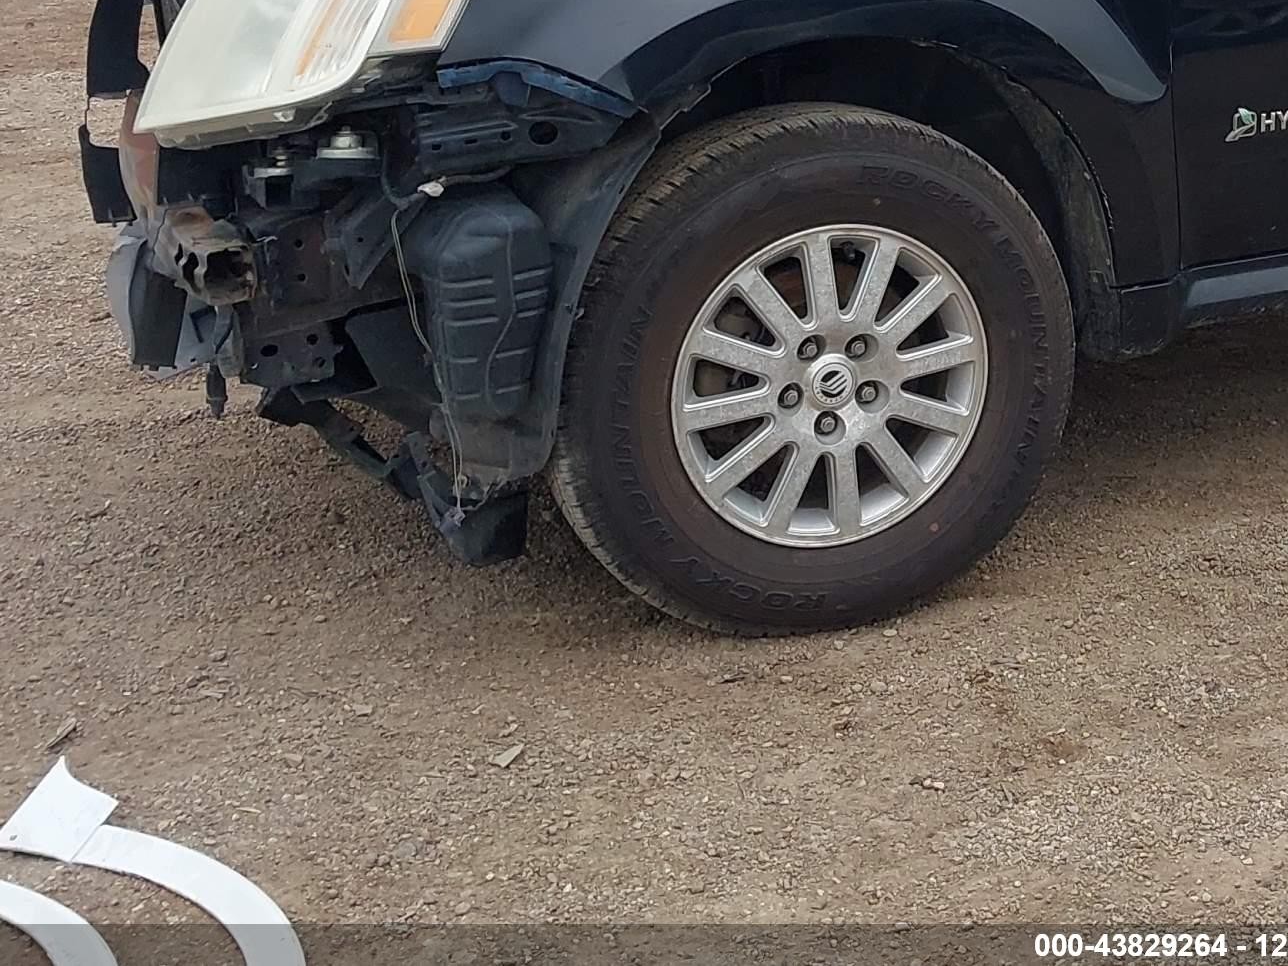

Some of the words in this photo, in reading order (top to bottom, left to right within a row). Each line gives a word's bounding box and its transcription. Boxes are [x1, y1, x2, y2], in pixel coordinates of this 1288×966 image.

[613, 310, 675, 546] MOUNTAIN
[859, 164, 996, 232] ROCKY
[997, 233, 1050, 472] MOUNTAIN
[672, 553, 832, 612] ROCKY
